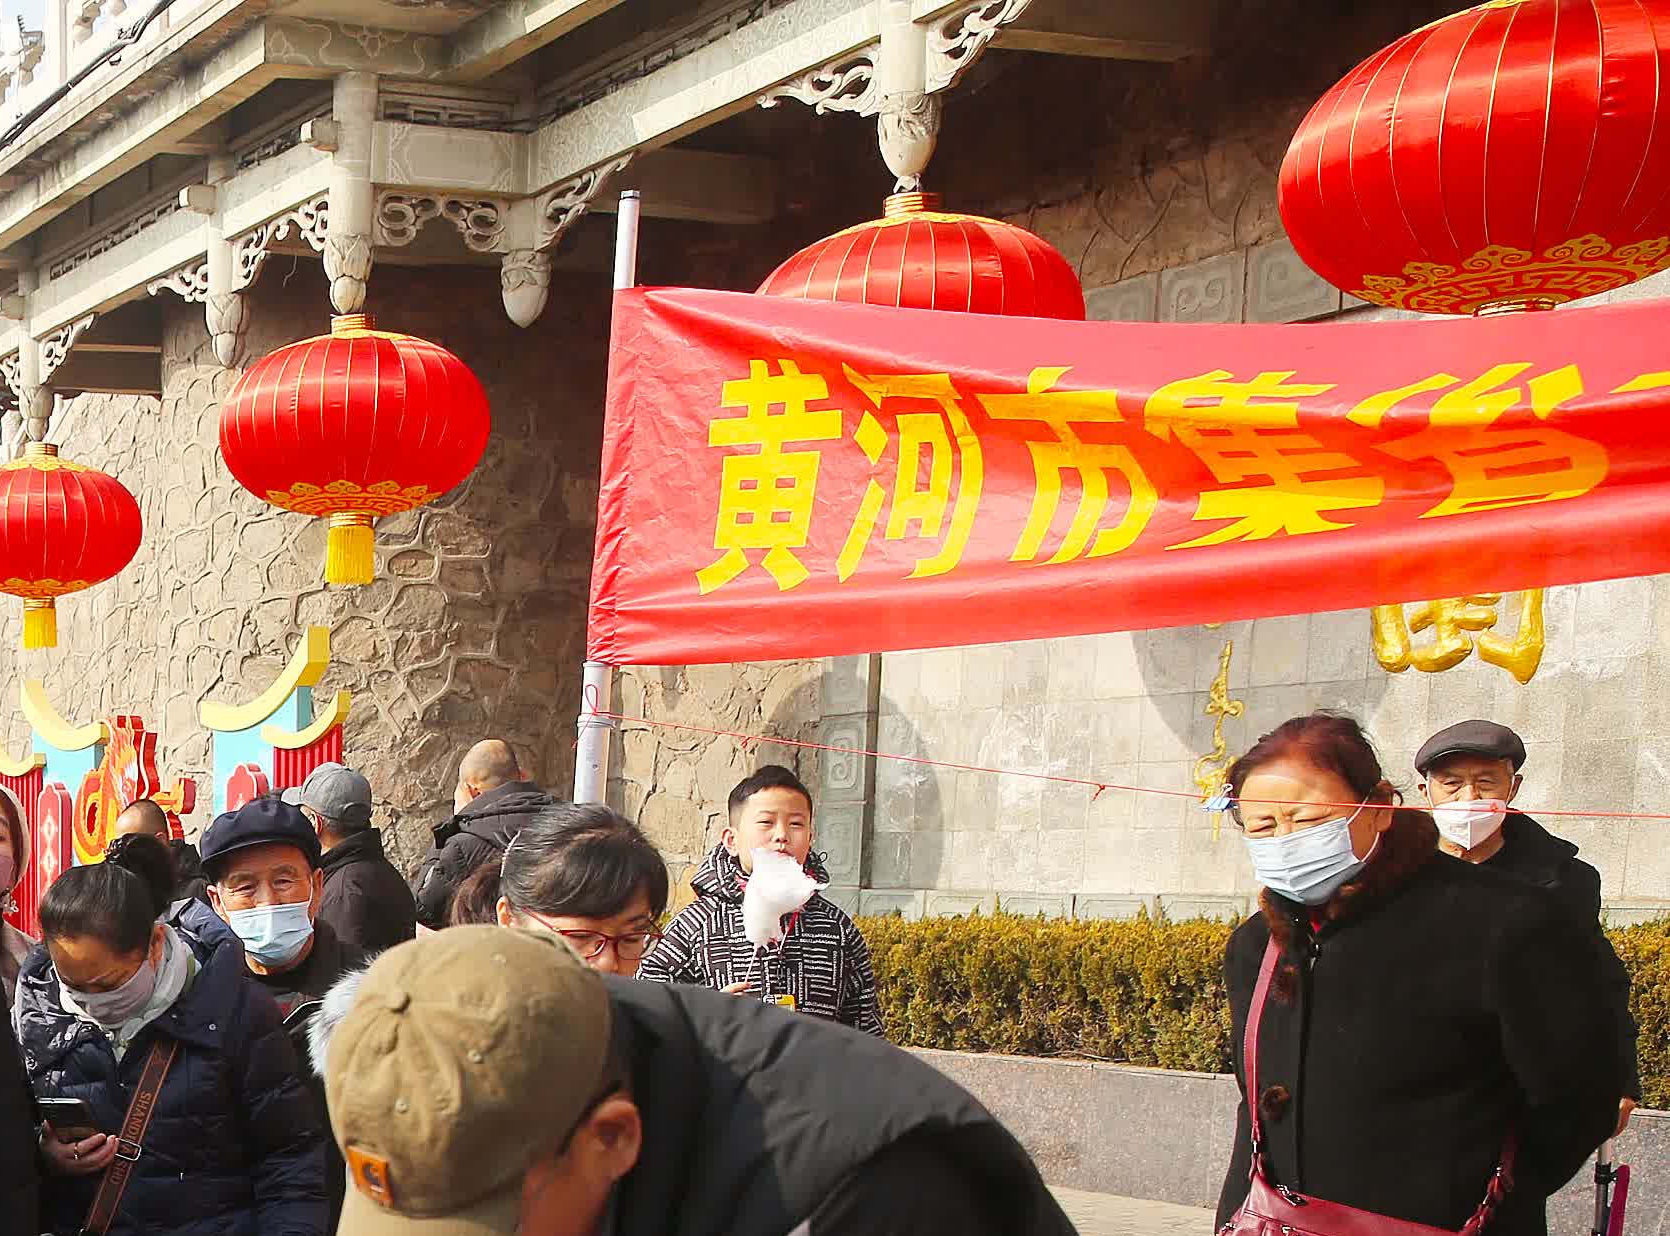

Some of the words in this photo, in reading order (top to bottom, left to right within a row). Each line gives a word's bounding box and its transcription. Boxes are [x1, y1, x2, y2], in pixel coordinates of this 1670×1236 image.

[696, 359, 1670, 595] 黄河市集省
